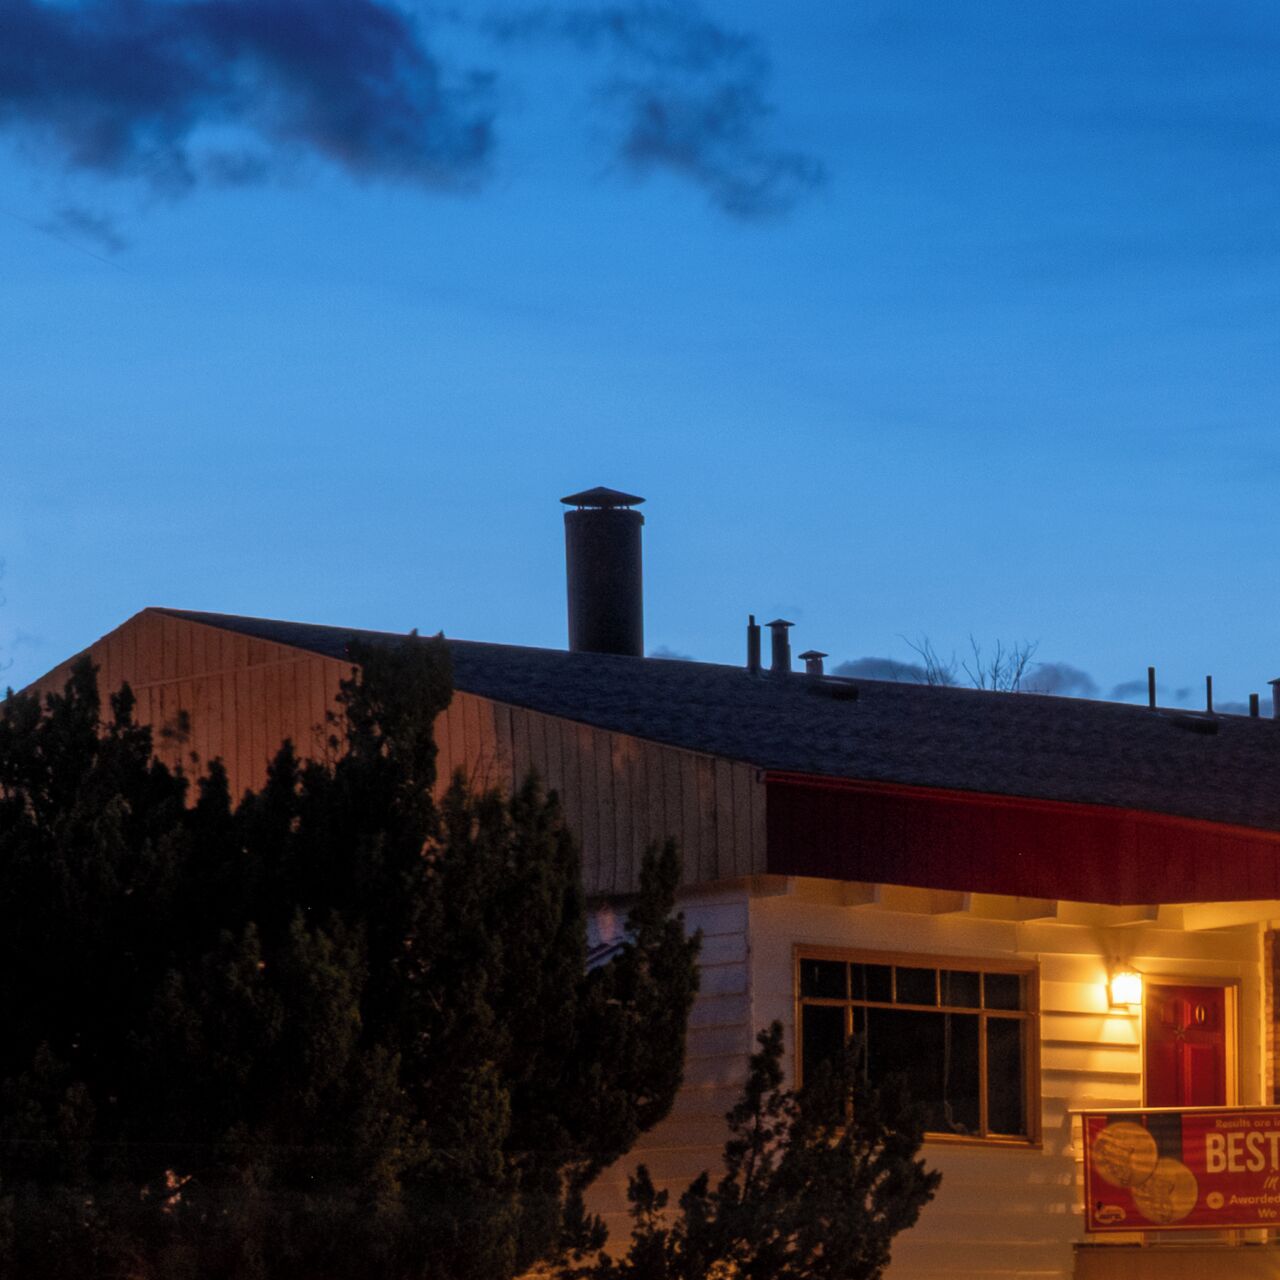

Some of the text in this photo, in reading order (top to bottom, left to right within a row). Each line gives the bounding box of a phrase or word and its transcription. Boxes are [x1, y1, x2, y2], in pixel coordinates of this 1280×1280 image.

[1216, 1118, 1250, 1129] Results
[1253, 1120, 1271, 1129] are
[1264, 1169, 1280, 1191] in
[1258, 1207, 1278, 1218] We
